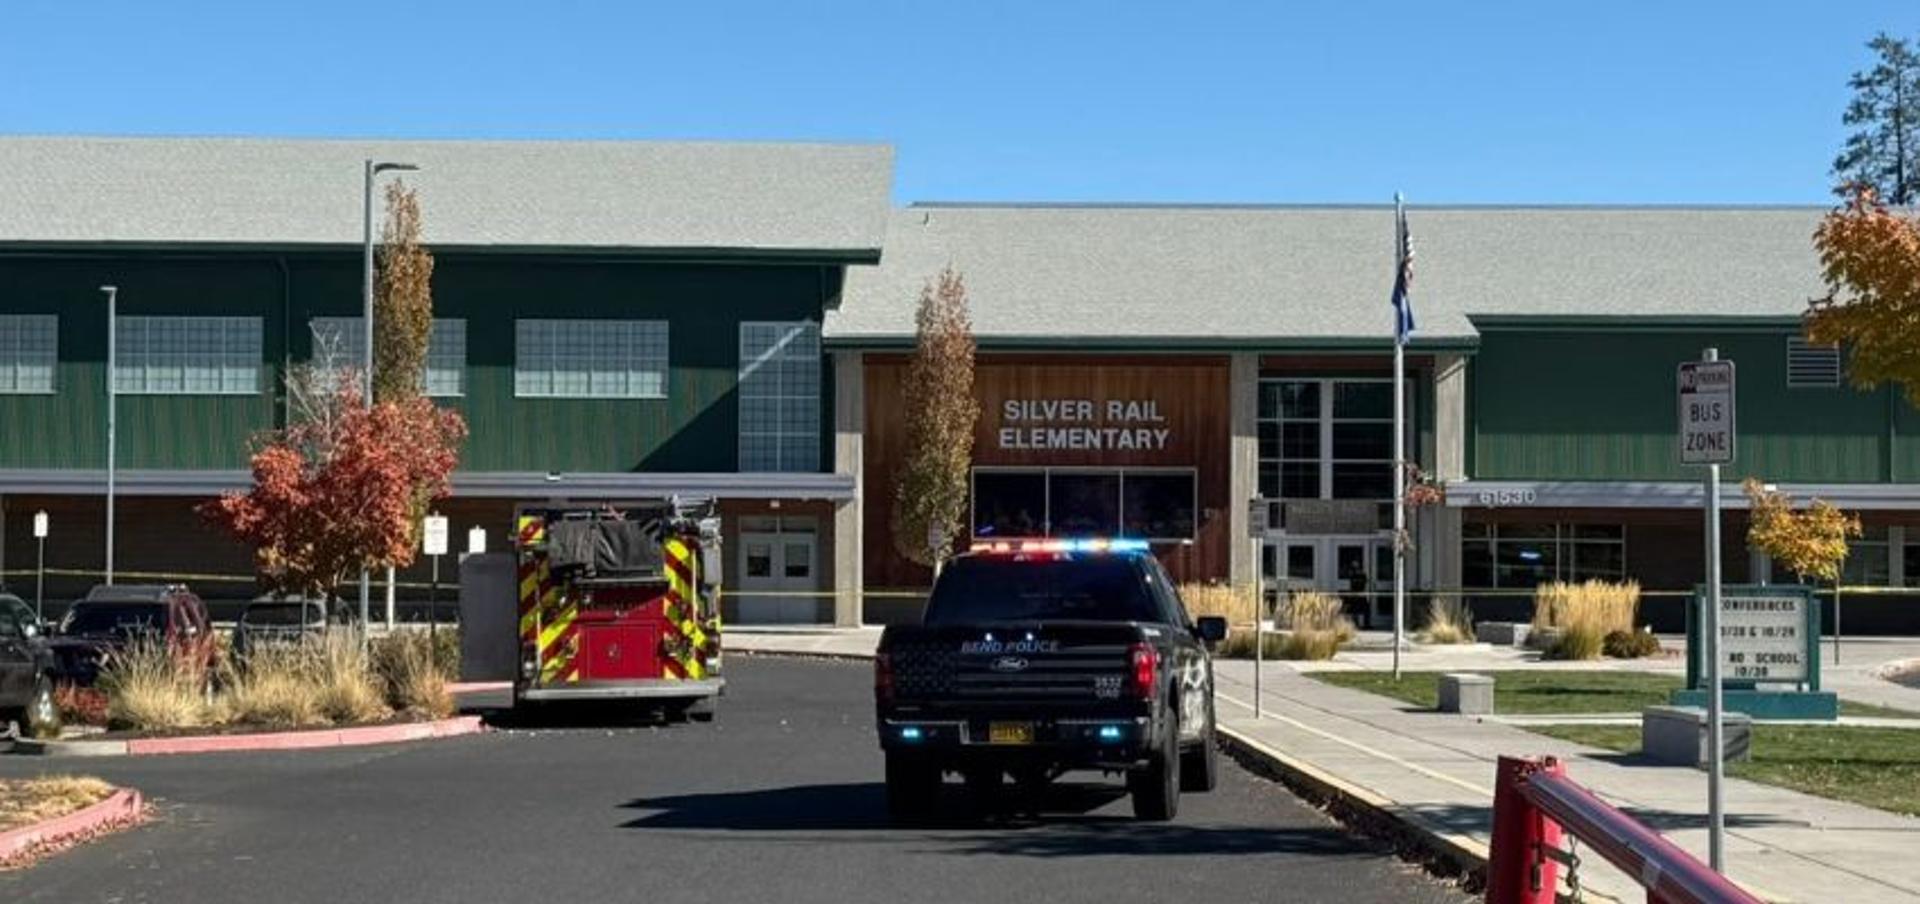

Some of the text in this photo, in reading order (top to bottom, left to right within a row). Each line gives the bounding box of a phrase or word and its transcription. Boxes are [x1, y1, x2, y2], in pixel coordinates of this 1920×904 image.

[1003, 400, 1164, 422] SILVER RAIL
[1690, 402, 1721, 422] BUS
[999, 428, 1169, 449] ELEMENTARY
[1686, 431, 1726, 451] ZONE
[1479, 489, 1536, 505] 61530
[1720, 600, 1795, 611] ONFERENCES
[961, 641, 1059, 653] BEND POLICE
[1730, 652, 1799, 664] NO SCHOOL
